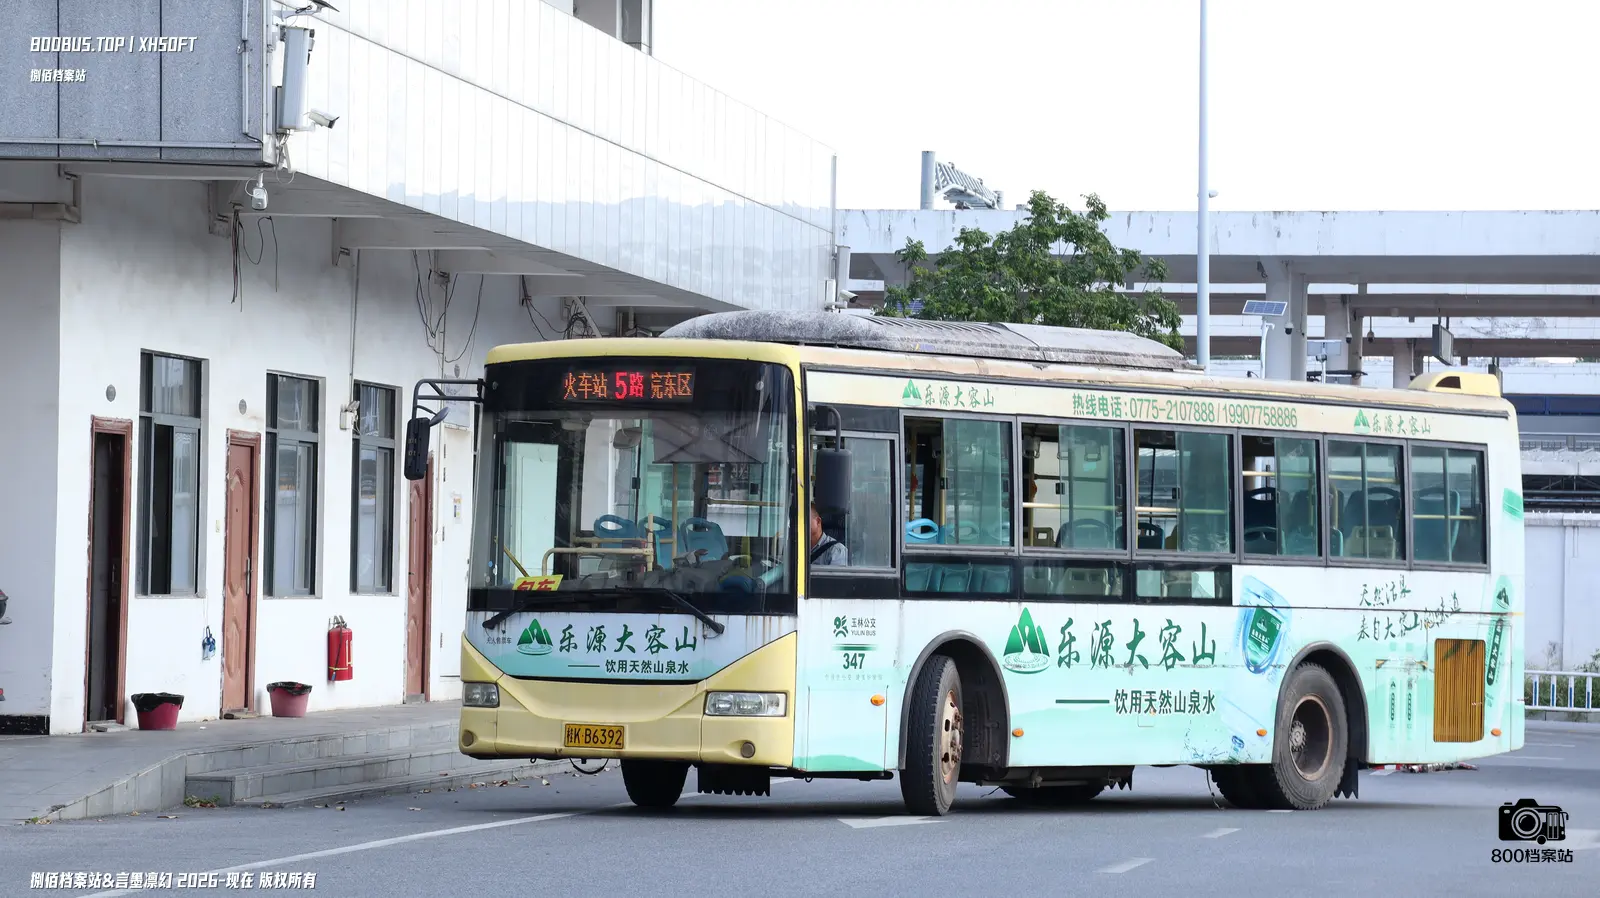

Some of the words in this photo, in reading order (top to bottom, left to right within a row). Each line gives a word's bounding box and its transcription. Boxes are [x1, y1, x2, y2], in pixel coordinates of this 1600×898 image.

[564, 372, 608, 400] 火车站
[615, 372, 645, 400] 5路
[924, 384, 995, 408] 乐源大容山
[1372, 413, 1431, 436] 乐源大容山
[559, 623, 698, 655] 乐源大容山
[1057, 617, 1217, 672] 乐源大容山
[605, 659, 690, 674] 饮用天然山泉水
[843, 652, 866, 670] 347
[1114, 688, 1216, 715] 饮用天然山泉水
